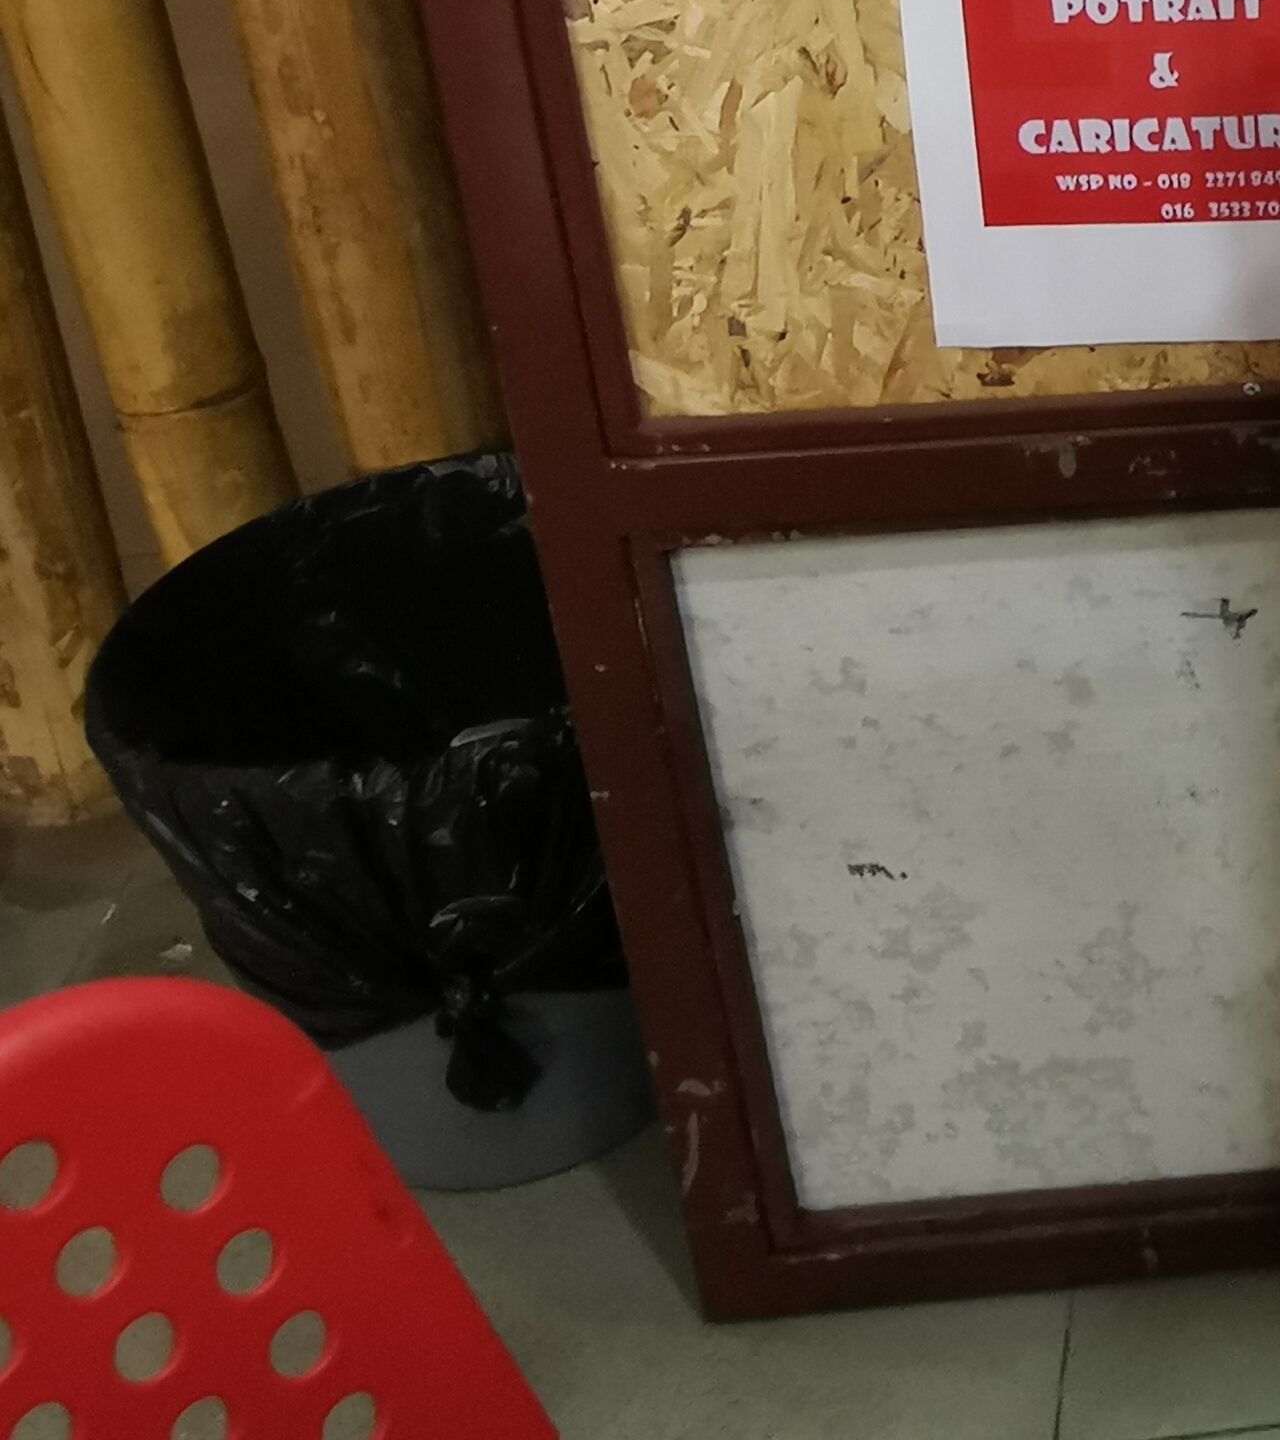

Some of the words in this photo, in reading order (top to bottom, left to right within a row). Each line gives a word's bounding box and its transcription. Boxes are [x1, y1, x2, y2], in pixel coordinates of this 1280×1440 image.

[1149, 51, 1180, 89] &
[1055, 174, 1104, 191] WSP
[1108, 173, 1138, 191] NO
[1157, 172, 1191, 190] 018
[1160, 203, 1196, 220] 016
